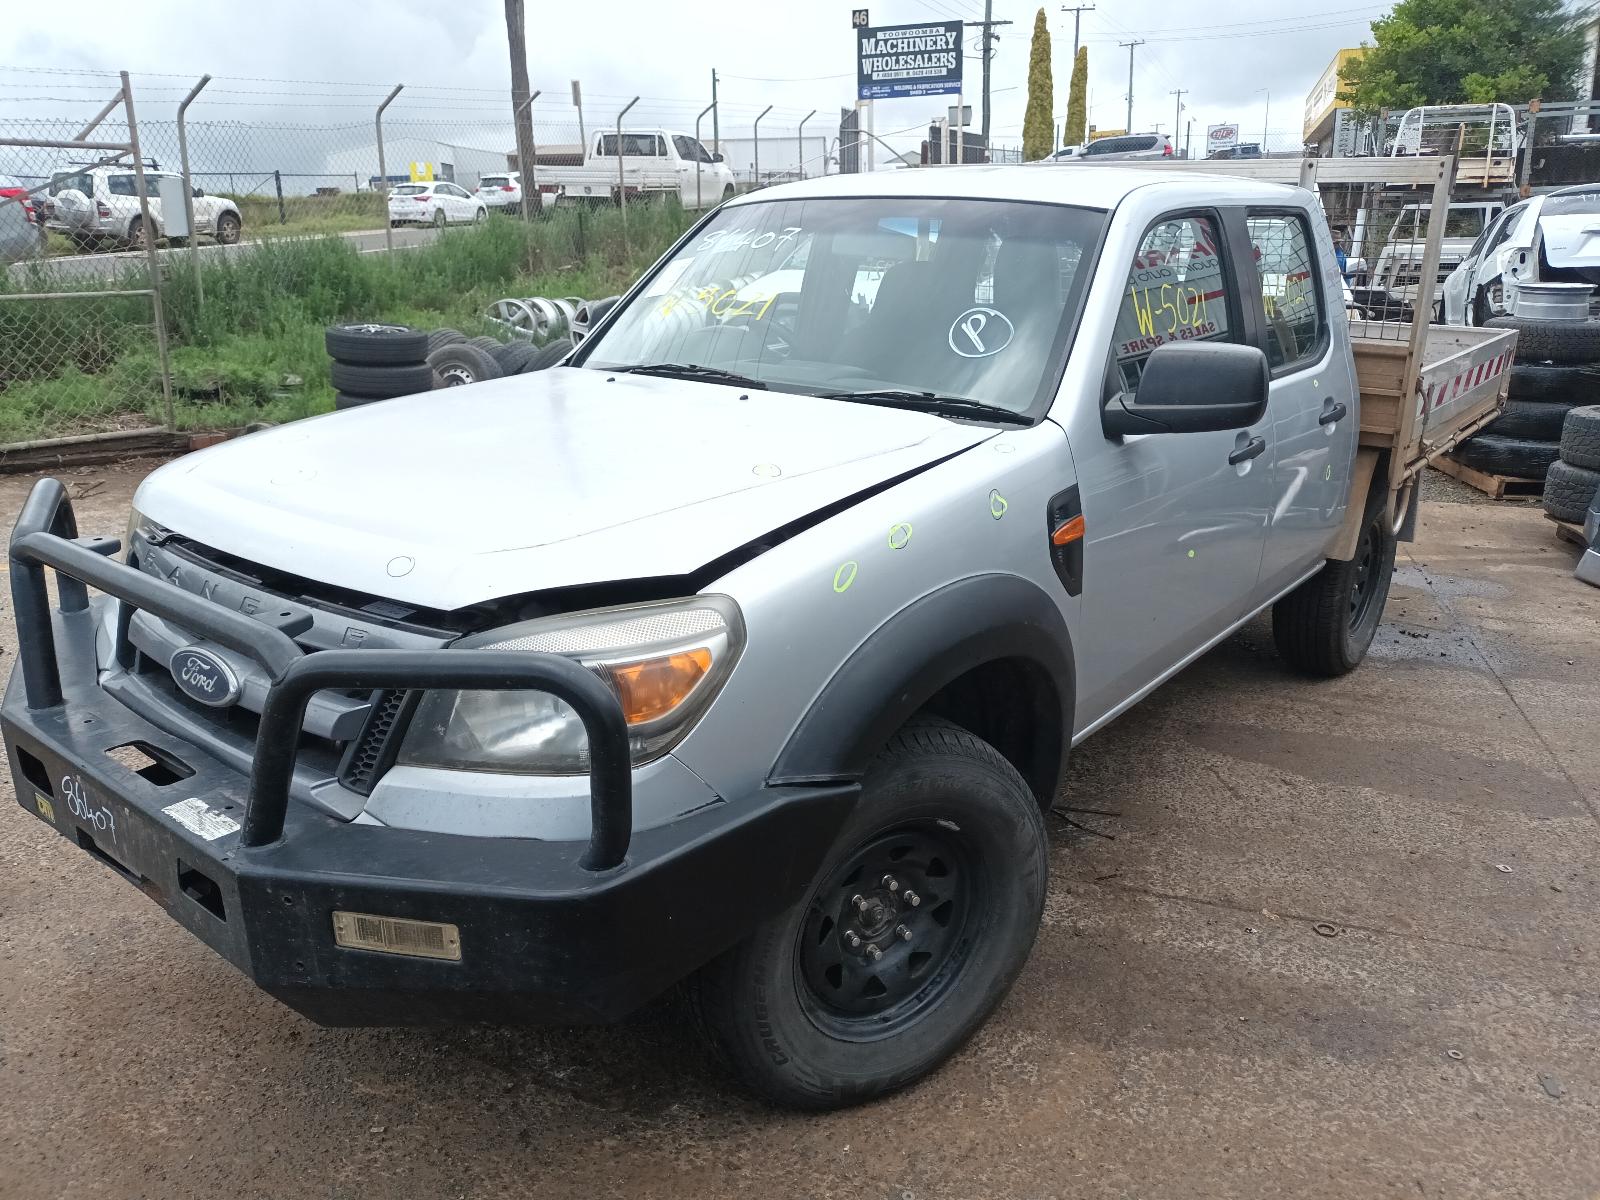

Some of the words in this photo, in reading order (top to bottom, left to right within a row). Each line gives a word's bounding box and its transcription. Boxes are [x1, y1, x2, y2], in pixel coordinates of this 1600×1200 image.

[853, 11, 868, 25] 46
[883, 28, 941, 38] TOOWOOMBA
[862, 31, 957, 55] MACHINERY
[862, 52, 957, 75] WHOLESALERS
[1131, 284, 1208, 337] W-5021
[142, 551, 369, 650] RANGR
[181, 655, 218, 693] Ford
[61, 775, 117, 845] 86407
